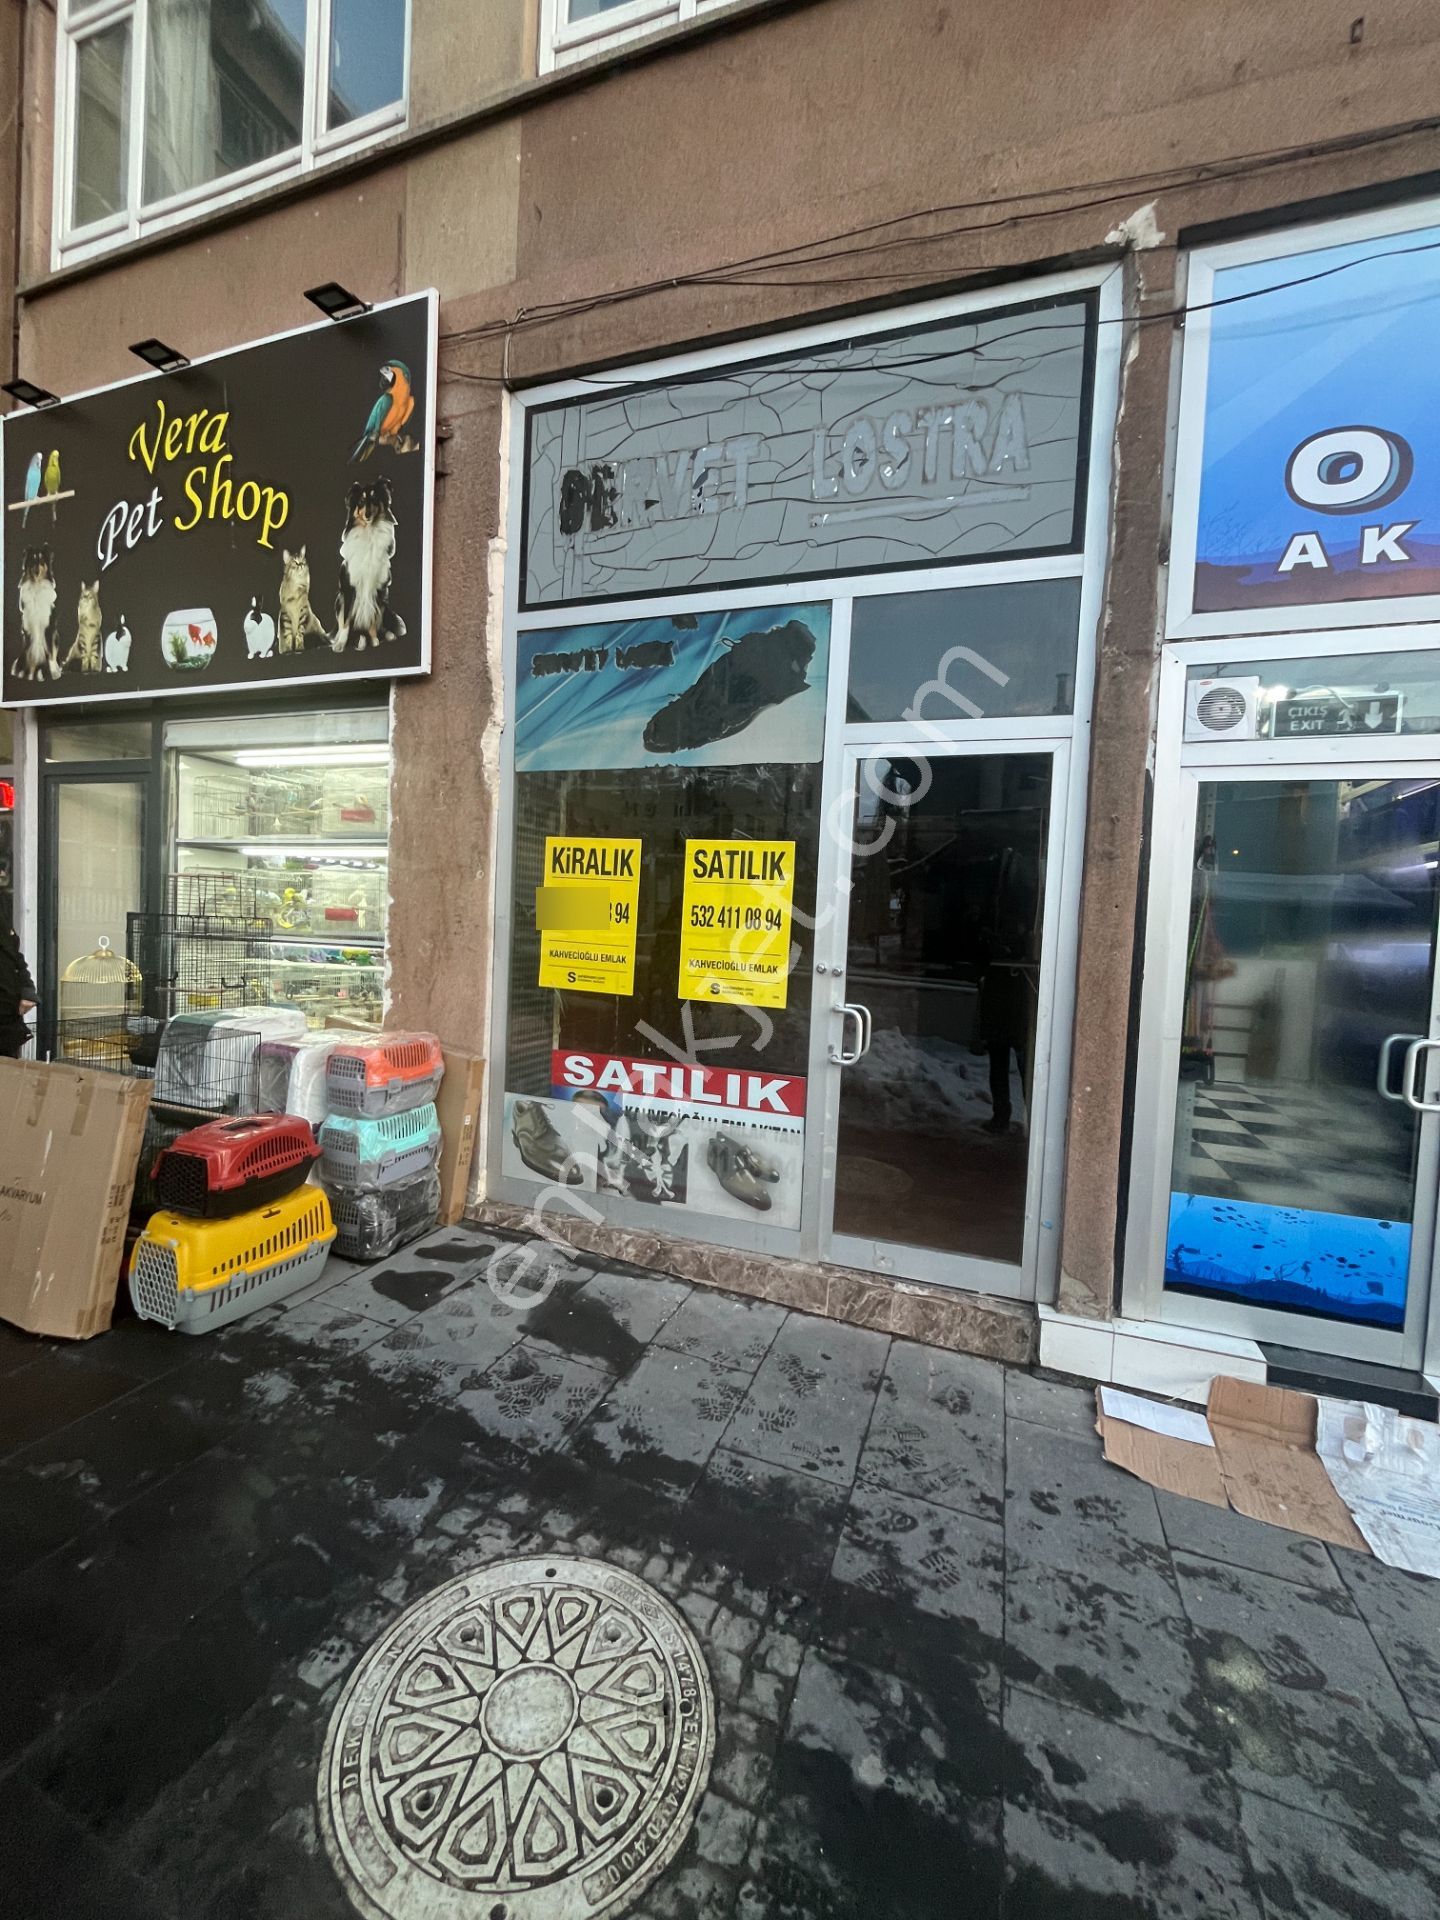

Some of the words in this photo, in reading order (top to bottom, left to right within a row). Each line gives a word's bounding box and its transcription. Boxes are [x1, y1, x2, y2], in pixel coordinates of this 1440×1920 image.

[128, 400, 230, 475] Vera
[97, 487, 163, 571] Pet
[174, 454, 289, 549] Shop
[1290, 720, 1325, 731] EXIT
[692, 849, 786, 881] SATILIK
[691, 905, 715, 928] 532
[717, 906, 740, 929] 411
[745, 907, 761, 931] 08
[765, 908, 782, 931] 94
[600, 955, 627, 964] EMLAK
[748, 963, 778, 974] EMLAK
[563, 1055, 793, 1113] SATILIK
[673, 1651, 697, 1697] 1478
